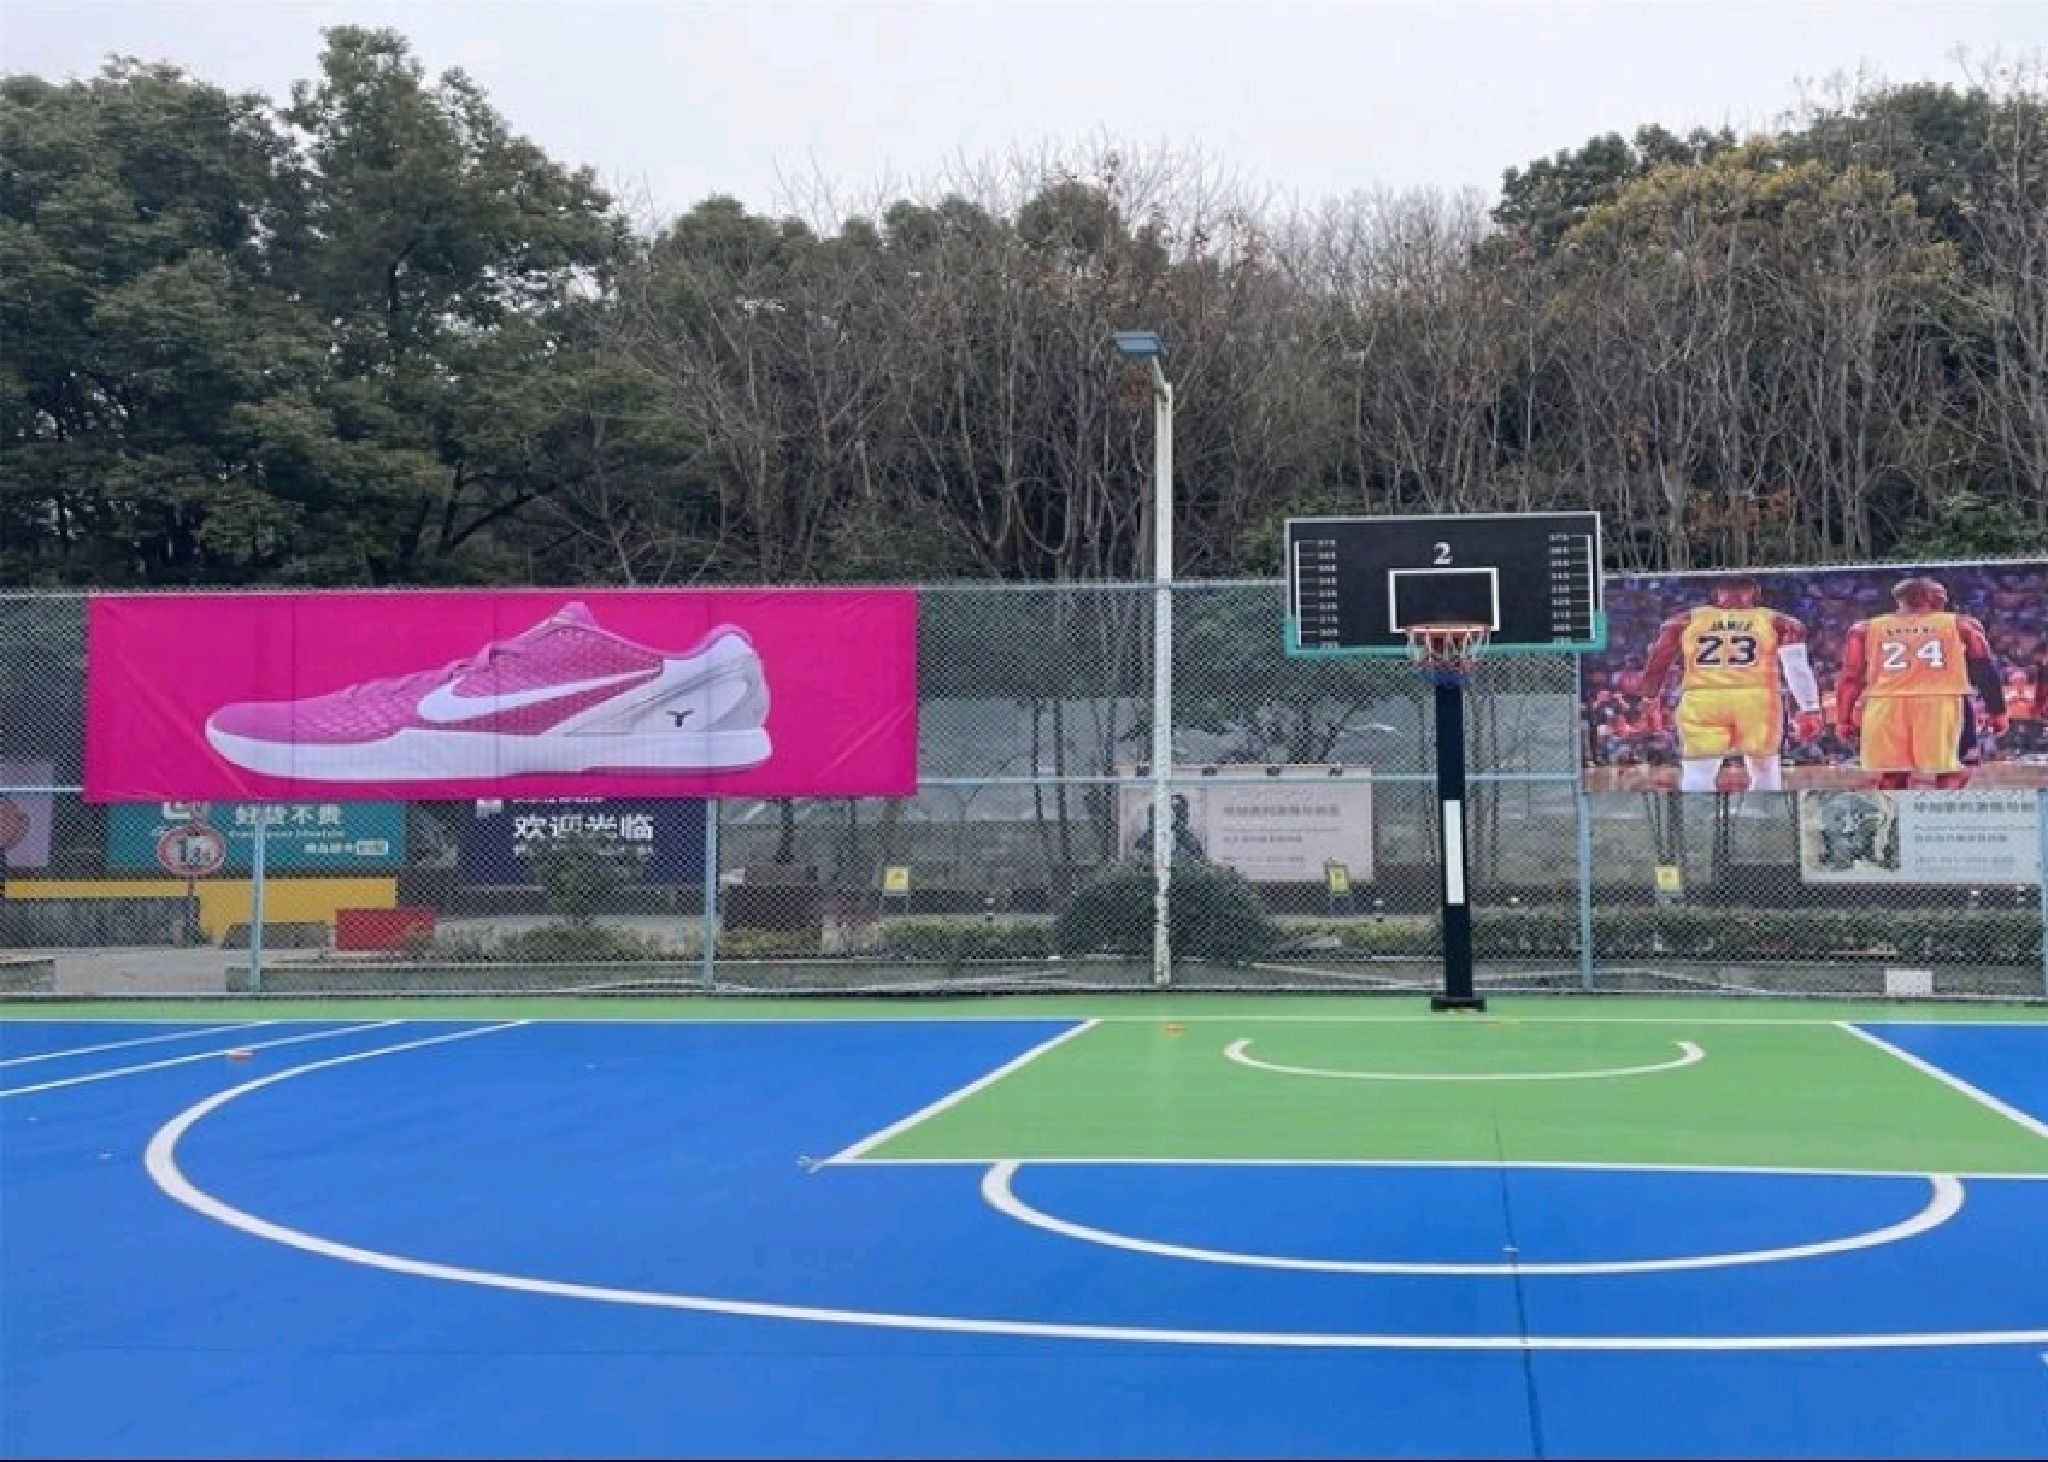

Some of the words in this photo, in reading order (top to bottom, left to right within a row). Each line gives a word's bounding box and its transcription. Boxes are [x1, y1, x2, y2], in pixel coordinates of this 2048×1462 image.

[1433, 541, 1453, 565] 2
[1695, 636, 1757, 666] 23
[1881, 640, 1945, 668] 24
[513, 813, 654, 840] 欢迎光临
